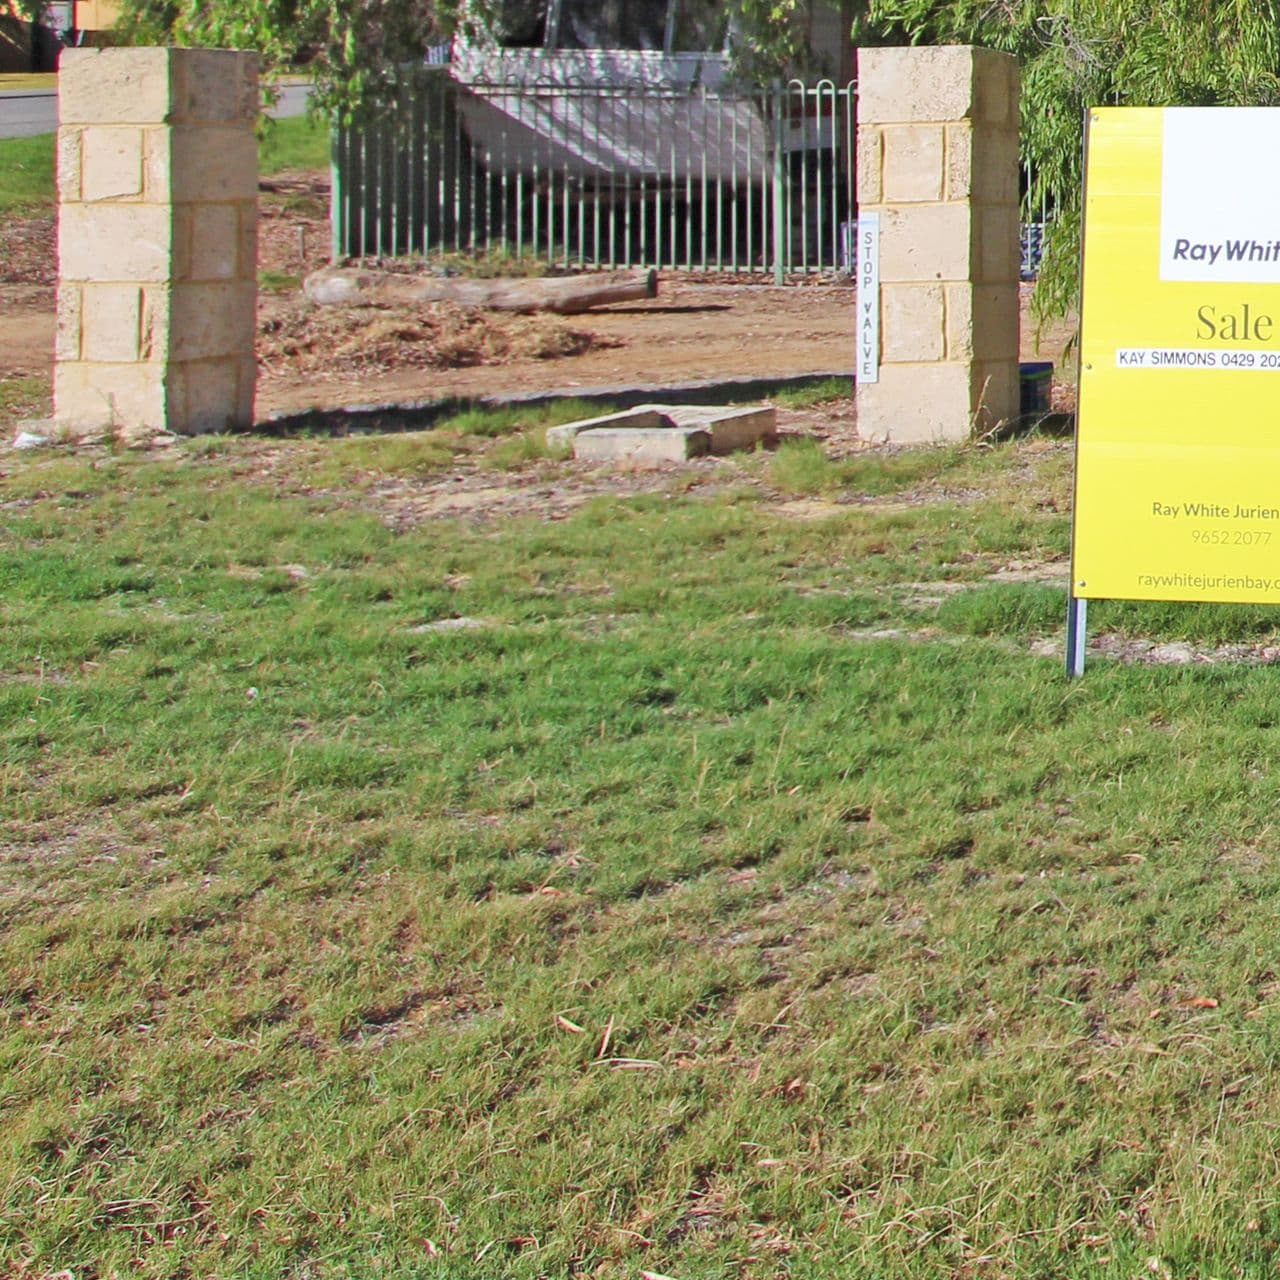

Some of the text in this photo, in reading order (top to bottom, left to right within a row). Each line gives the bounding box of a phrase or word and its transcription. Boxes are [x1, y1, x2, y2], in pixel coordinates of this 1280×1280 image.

[863, 231, 873, 375] STOP VALVE
[1196, 304, 1272, 341] Sale
[1119, 352, 1145, 365] KAY
[1151, 352, 1216, 366] SIMMONS
[1221, 354, 1254, 367] 0429
[1152, 502, 1179, 518] Ray
[1183, 503, 1229, 518] White
[1233, 504, 1280, 519] Jurien
[1191, 530, 1272, 545] 9652 2077
